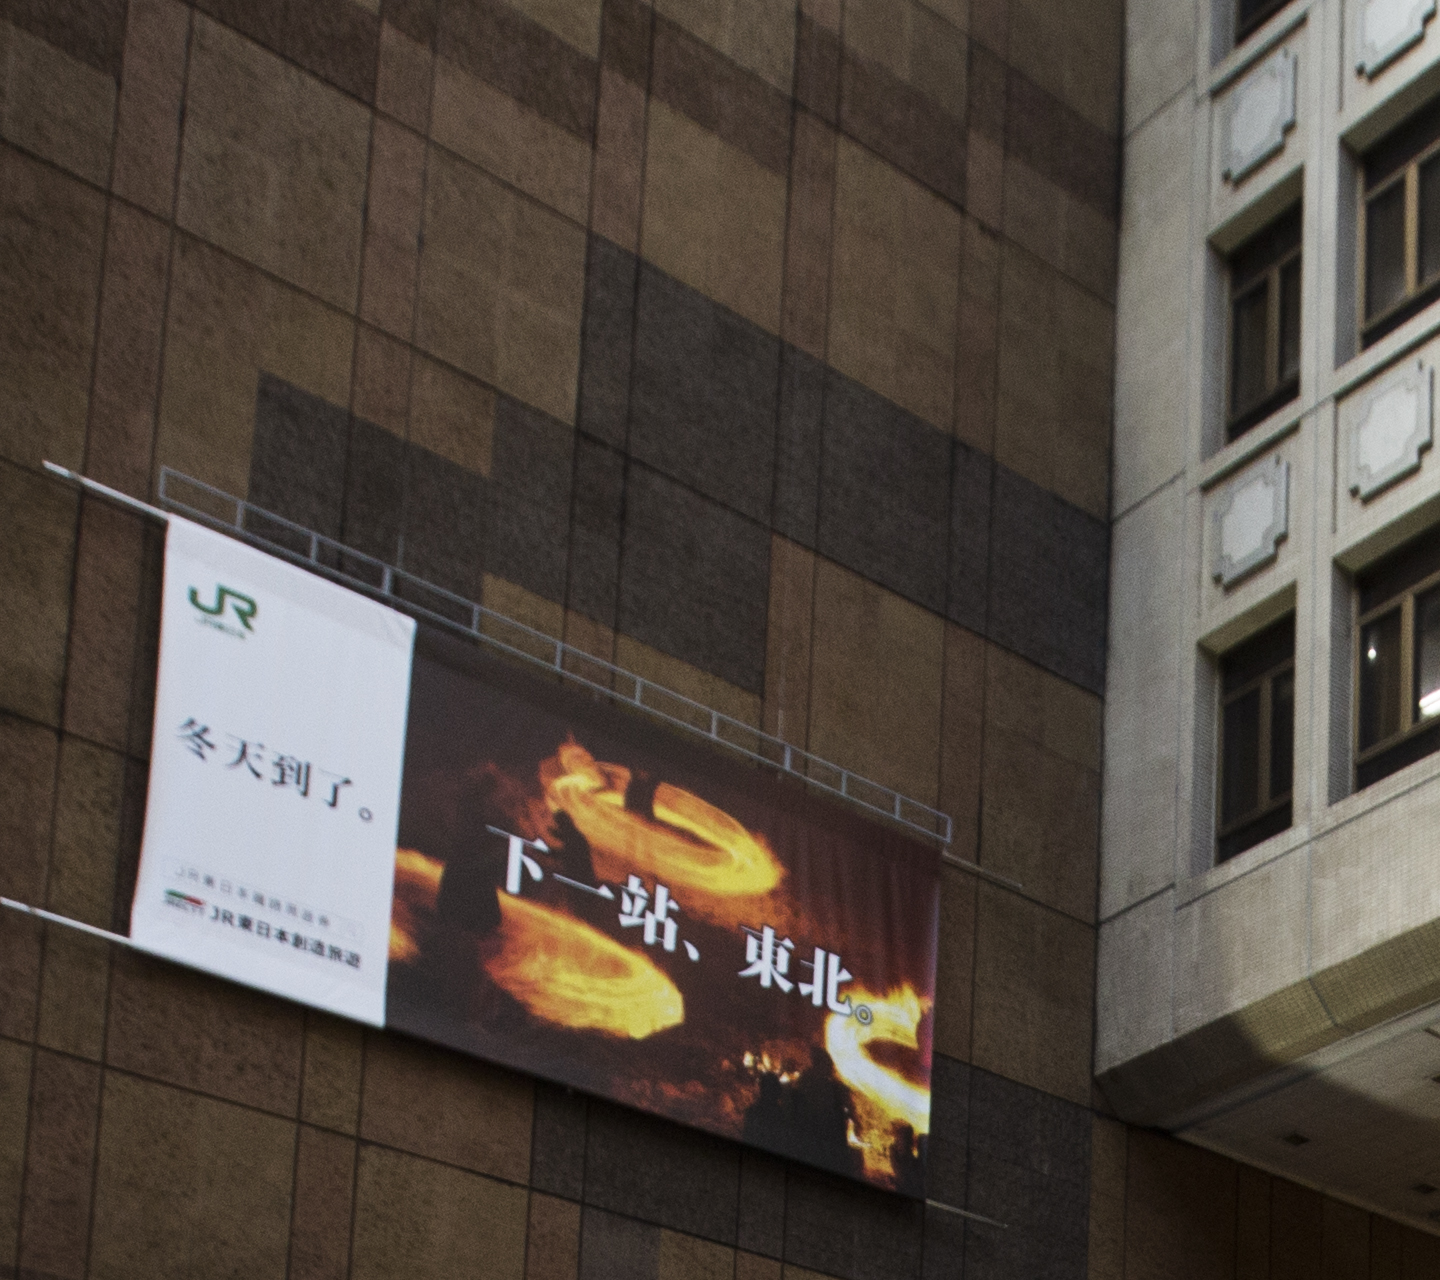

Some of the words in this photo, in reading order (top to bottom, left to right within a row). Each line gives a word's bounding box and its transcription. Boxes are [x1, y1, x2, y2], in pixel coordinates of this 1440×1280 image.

[187, 582, 258, 632] JR
[176, 716, 374, 823] 冬天到了。
